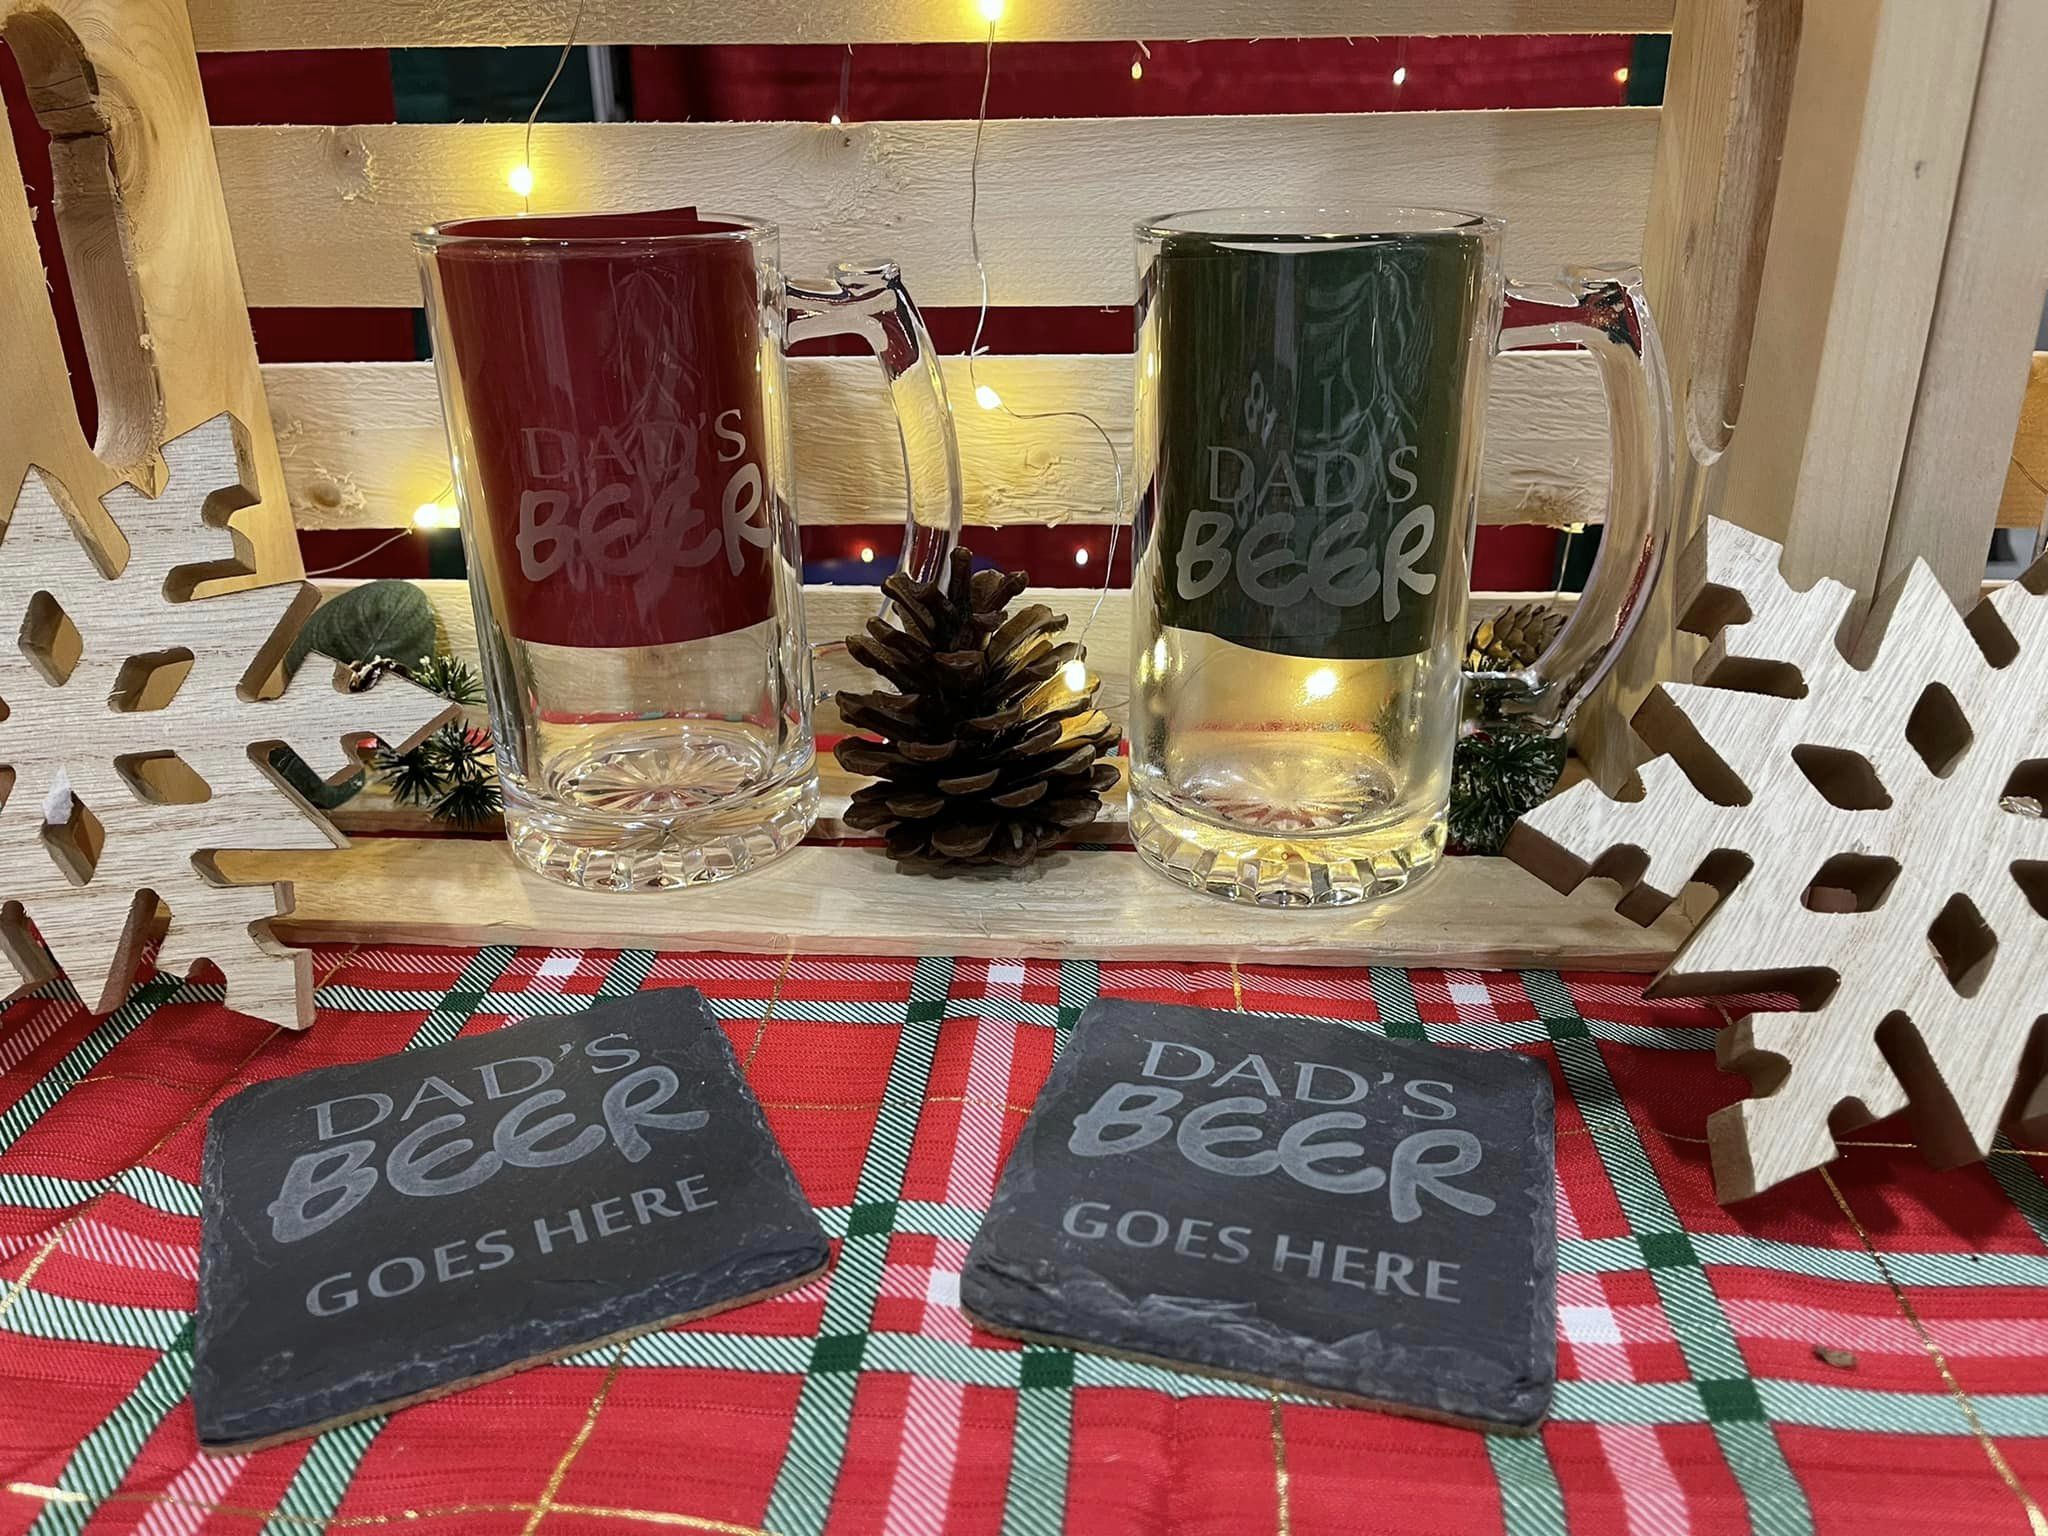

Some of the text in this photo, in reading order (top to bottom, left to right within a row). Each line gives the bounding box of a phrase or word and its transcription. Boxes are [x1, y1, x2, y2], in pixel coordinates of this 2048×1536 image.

[520, 409, 746, 478] DAD'S
[516, 463, 772, 582] BEER
[1176, 504, 1437, 622] BEER
[307, 1032, 640, 1140] DAD'S
[1141, 1039, 1457, 1120] DAD'S
[267, 1065, 710, 1244] BEER
[1068, 1082, 1496, 1223] BEER
[305, 1173, 718, 1317] GOES HERE
[1062, 1201, 1461, 1302] GOES HERE
